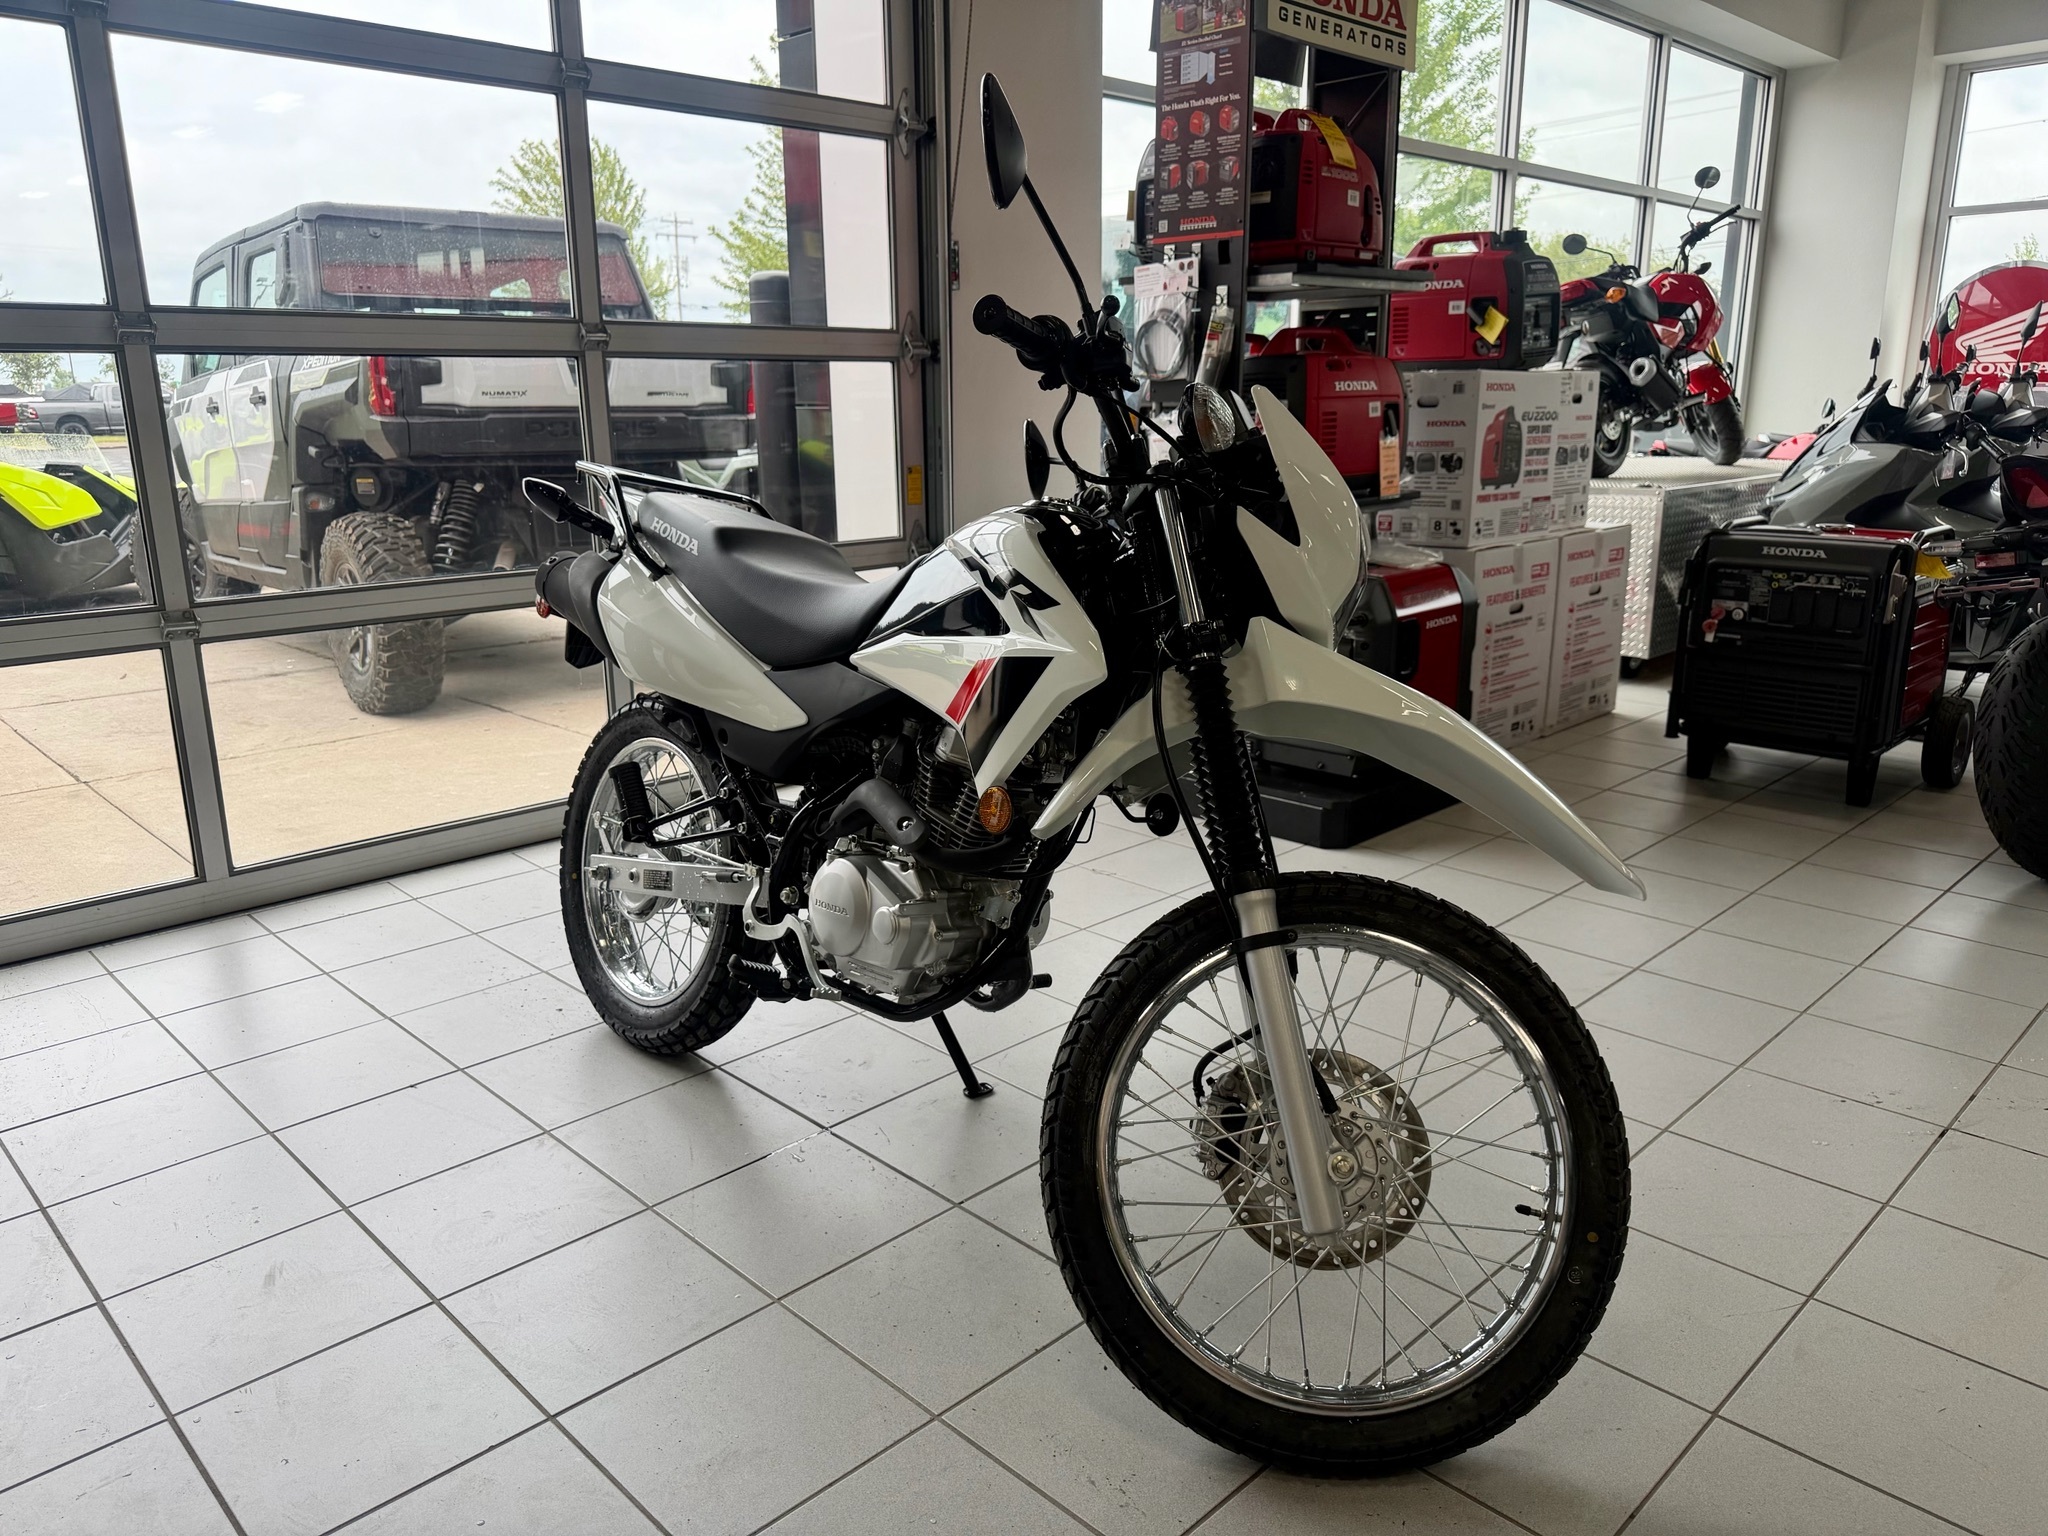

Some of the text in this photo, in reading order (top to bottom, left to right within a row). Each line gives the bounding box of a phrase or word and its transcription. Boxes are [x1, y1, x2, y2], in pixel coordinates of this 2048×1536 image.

[1278, 6, 1406, 56] GENERATORS
[1161, 104, 1171, 112] The
[1171, 101, 1189, 111] Honda
[1190, 98, 1204, 107] That's
[1205, 96, 1219, 106] Right
[1219, 95, 1229, 103] For
[1180, 215, 1217, 226] HONDA
[1423, 279, 1464, 291] ONDA
[1334, 380, 1378, 391] HONDA
[1485, 382, 1516, 392] HONDA
[525, 420, 658, 438] POLRIS
[1426, 420, 1467, 428] HONDA
[1434, 520, 1441, 531] 8
[649, 517, 699, 556] HONDA
[1567, 549, 1595, 562] HONDA
[1761, 546, 1827, 559] HONDA
[1482, 565, 1515, 578] HONDA
[1569, 573, 1594, 587] FEATURES
[1599, 567, 1621, 581] BENEFITS
[1486, 590, 1514, 606] FEATURES
[1520, 584, 1546, 599] BENEFITS
[1425, 614, 1457, 629] HONDA
[815, 898, 850, 918] HONDA
